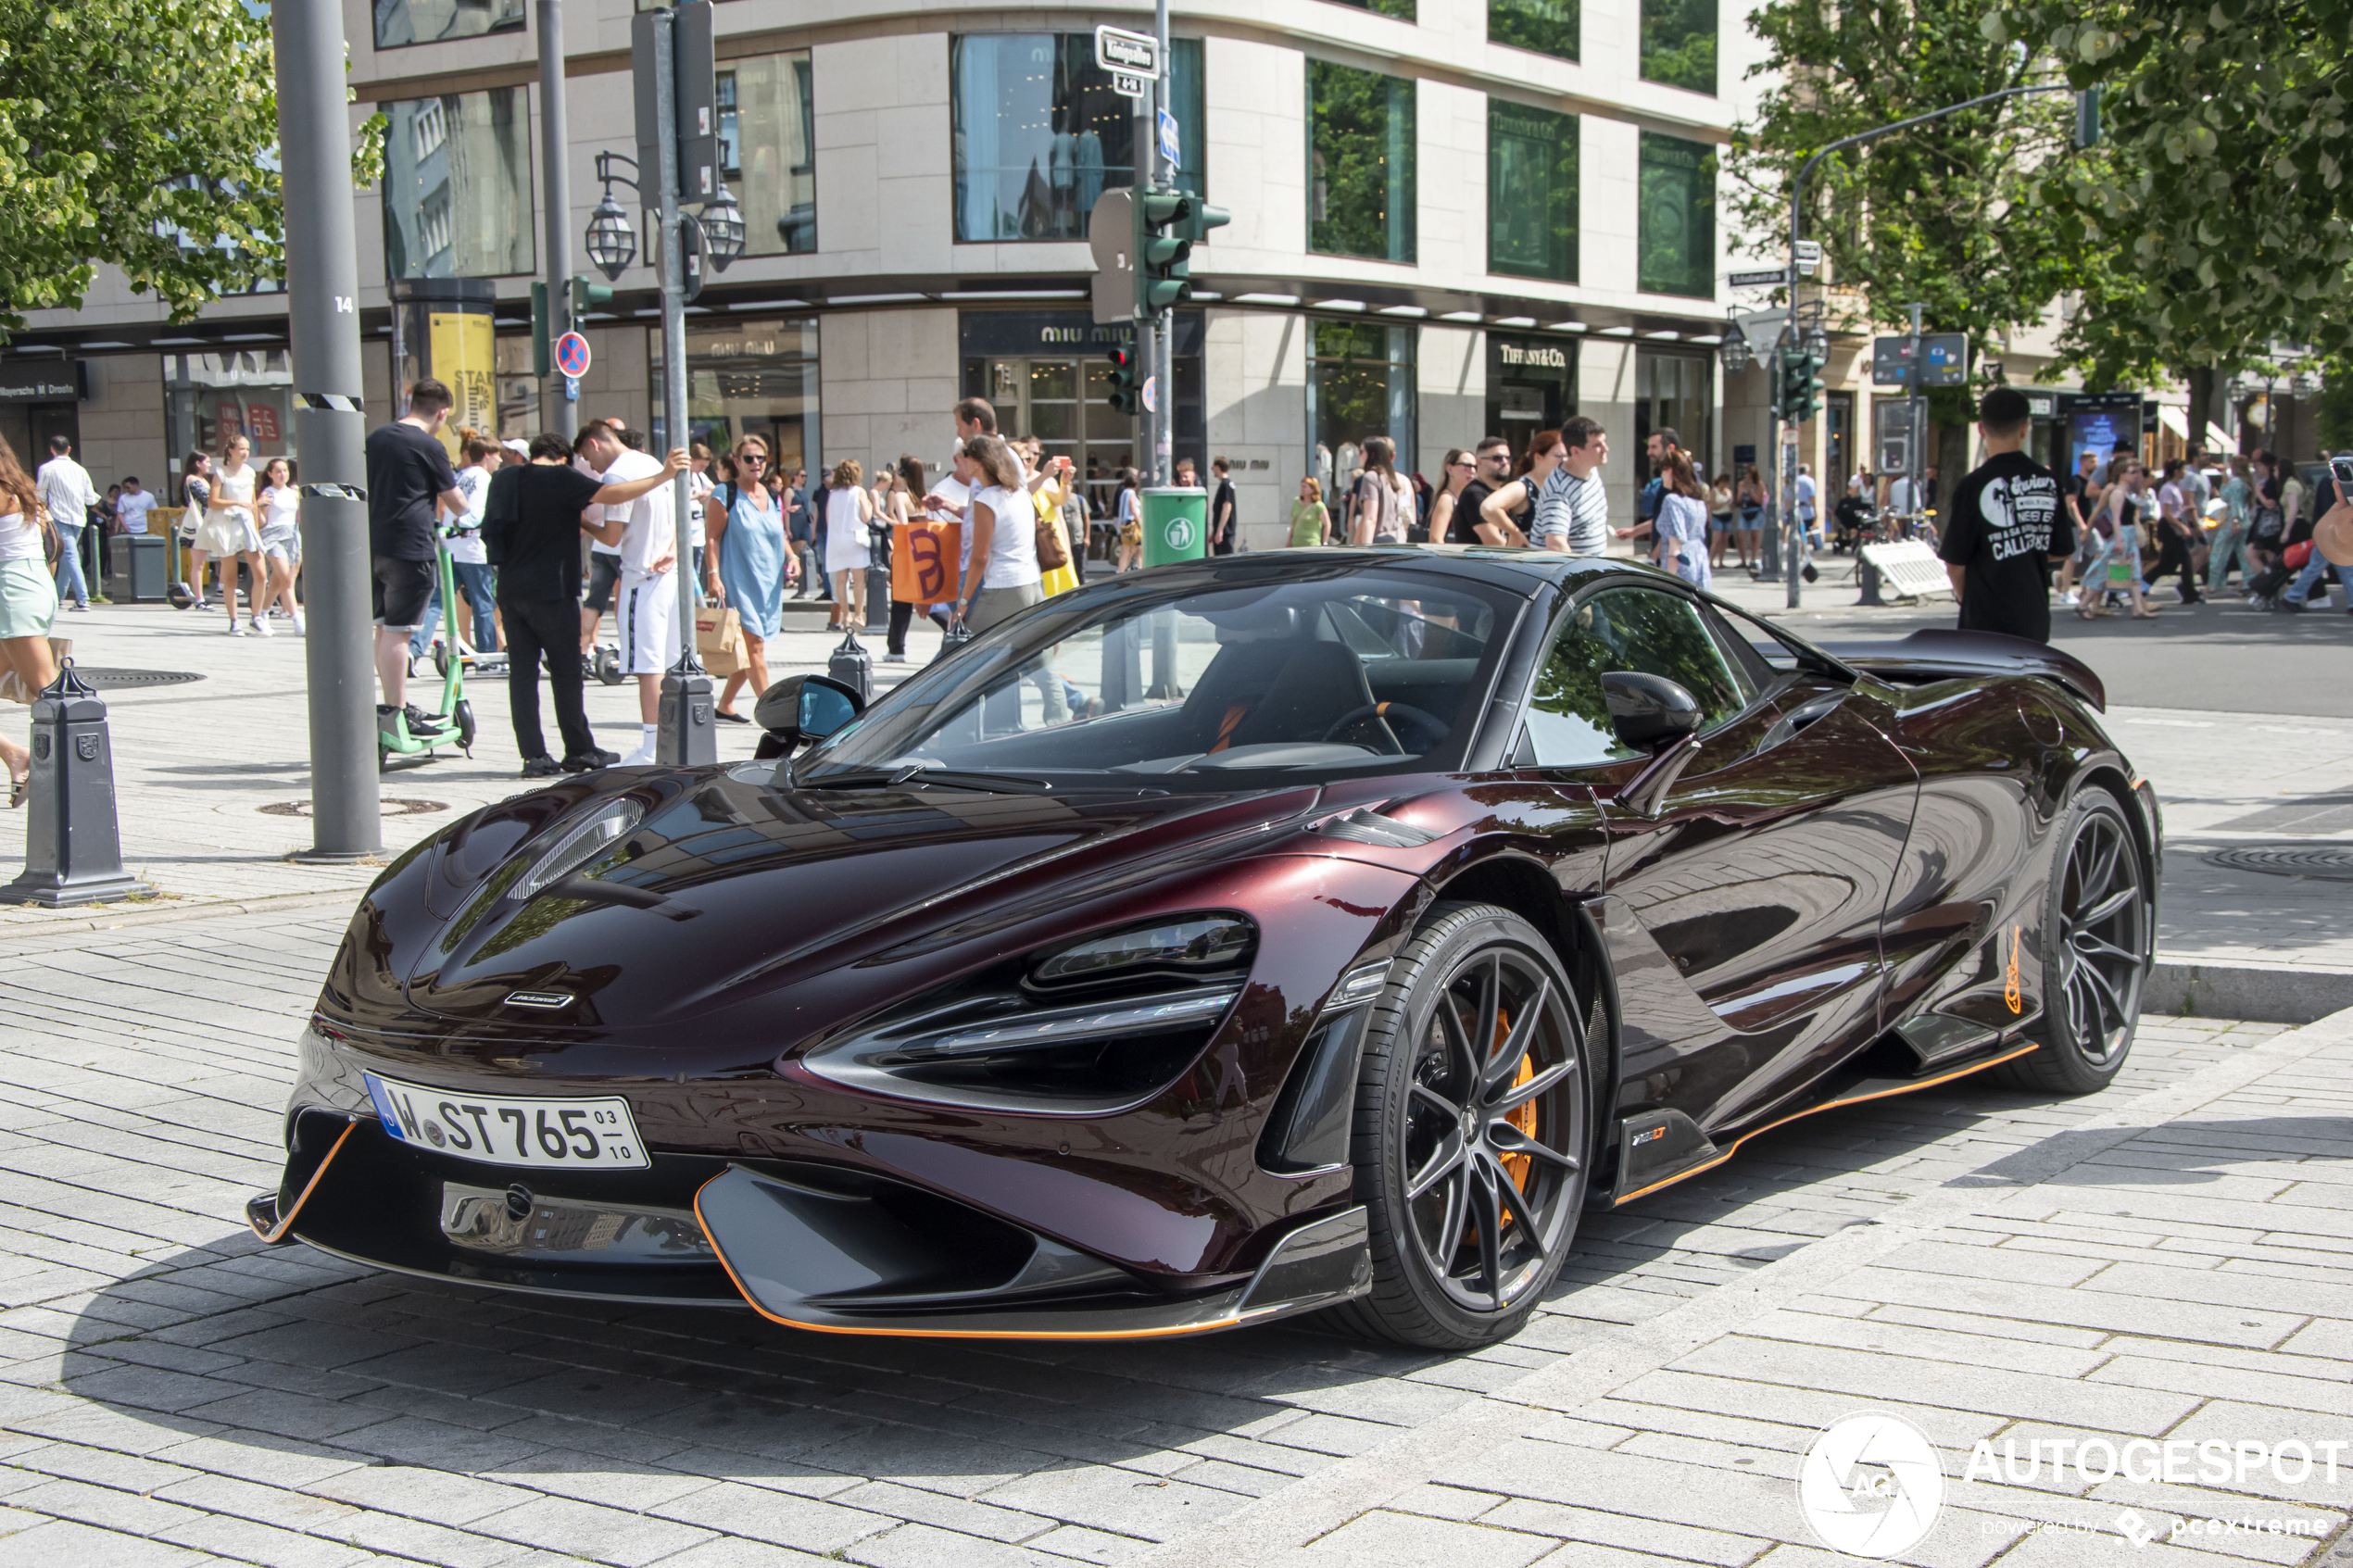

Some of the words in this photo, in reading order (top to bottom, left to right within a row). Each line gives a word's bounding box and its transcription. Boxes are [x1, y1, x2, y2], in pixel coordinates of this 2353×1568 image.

[334, 295, 354, 313] 14
[1041, 326, 1082, 343] miu
[48, 383, 73, 395] Droste
[1993, 537, 2027, 560] CALL
[387, 1088, 422, 1140] W
[438, 1101, 495, 1154] ST
[497, 1108, 601, 1160] 765
[594, 1110, 617, 1124] 03
[609, 1146, 632, 1160] 10
[1505, 1268, 1532, 1296] 765LT
